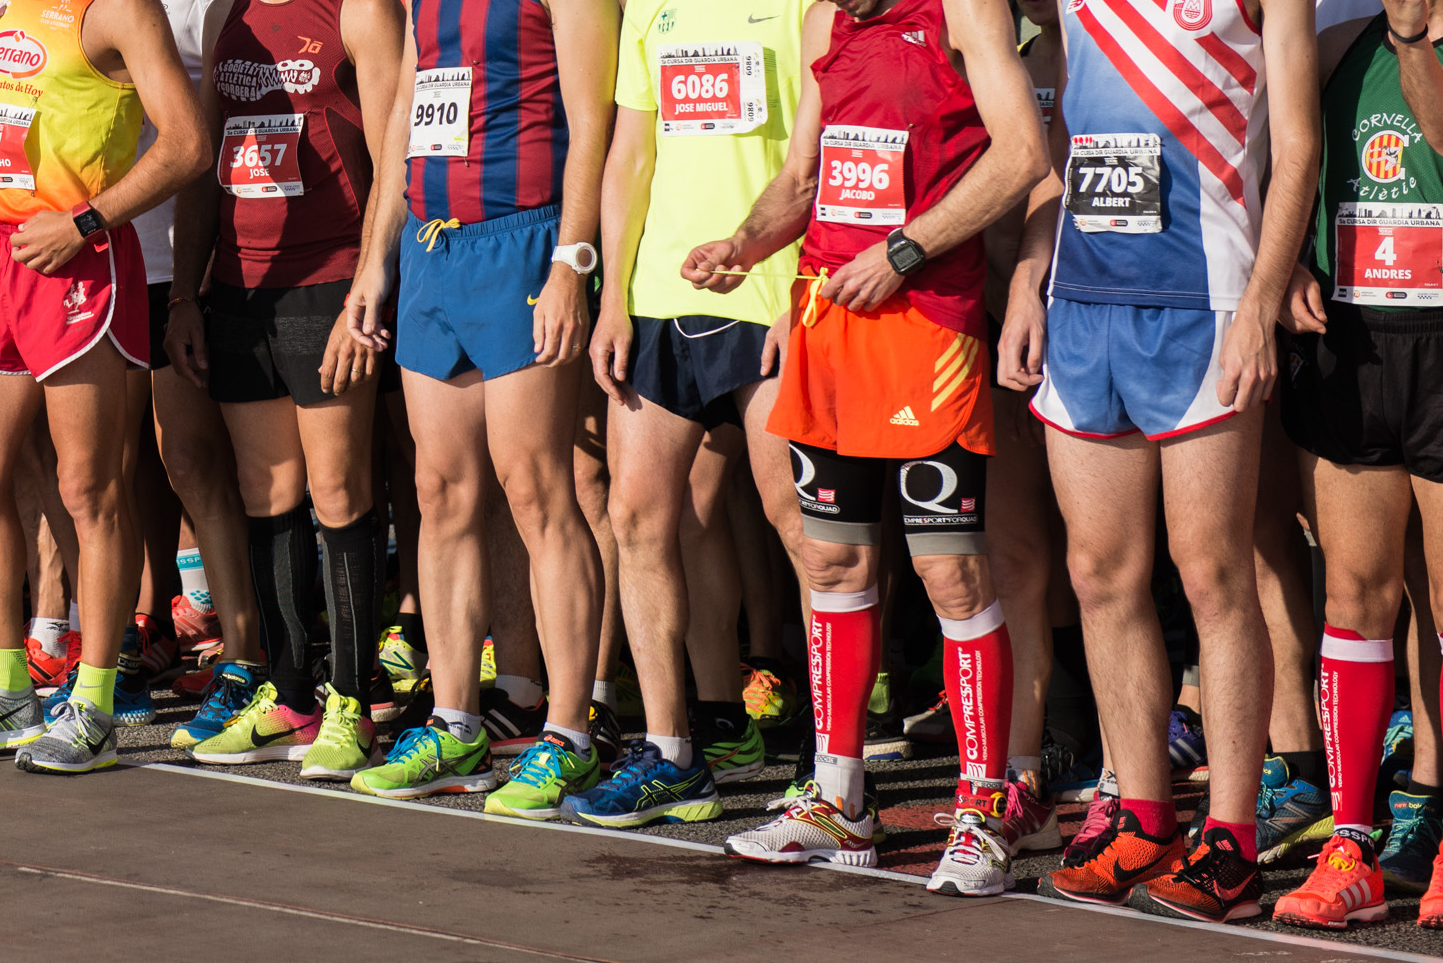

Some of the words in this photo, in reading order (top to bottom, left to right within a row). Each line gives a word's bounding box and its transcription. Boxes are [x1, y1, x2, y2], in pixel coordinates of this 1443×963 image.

[41, 9, 75, 23] SERRANO
[223, 63, 260, 76] SOCIETAT
[24, 83, 43, 97] Hoy
[671, 73, 729, 99] 6086
[414, 102, 458, 127] 9910
[674, 103, 694, 115] JOSE
[696, 102, 728, 112] MIGUEL
[230, 143, 287, 167] 3657
[250, 169, 270, 179] JOSE
[828, 159, 890, 190] 3996
[1078, 167, 1144, 193] 7705
[839, 189, 875, 201] JACOBO
[1092, 197, 1132, 207] ALBERT
[1374, 237, 1397, 266] 4
[1364, 269, 1412, 279] ANDRES
[890, 418, 920, 426] adidas
[900, 461, 958, 513] Q
[976, 683, 985, 717] COMPRESSION
